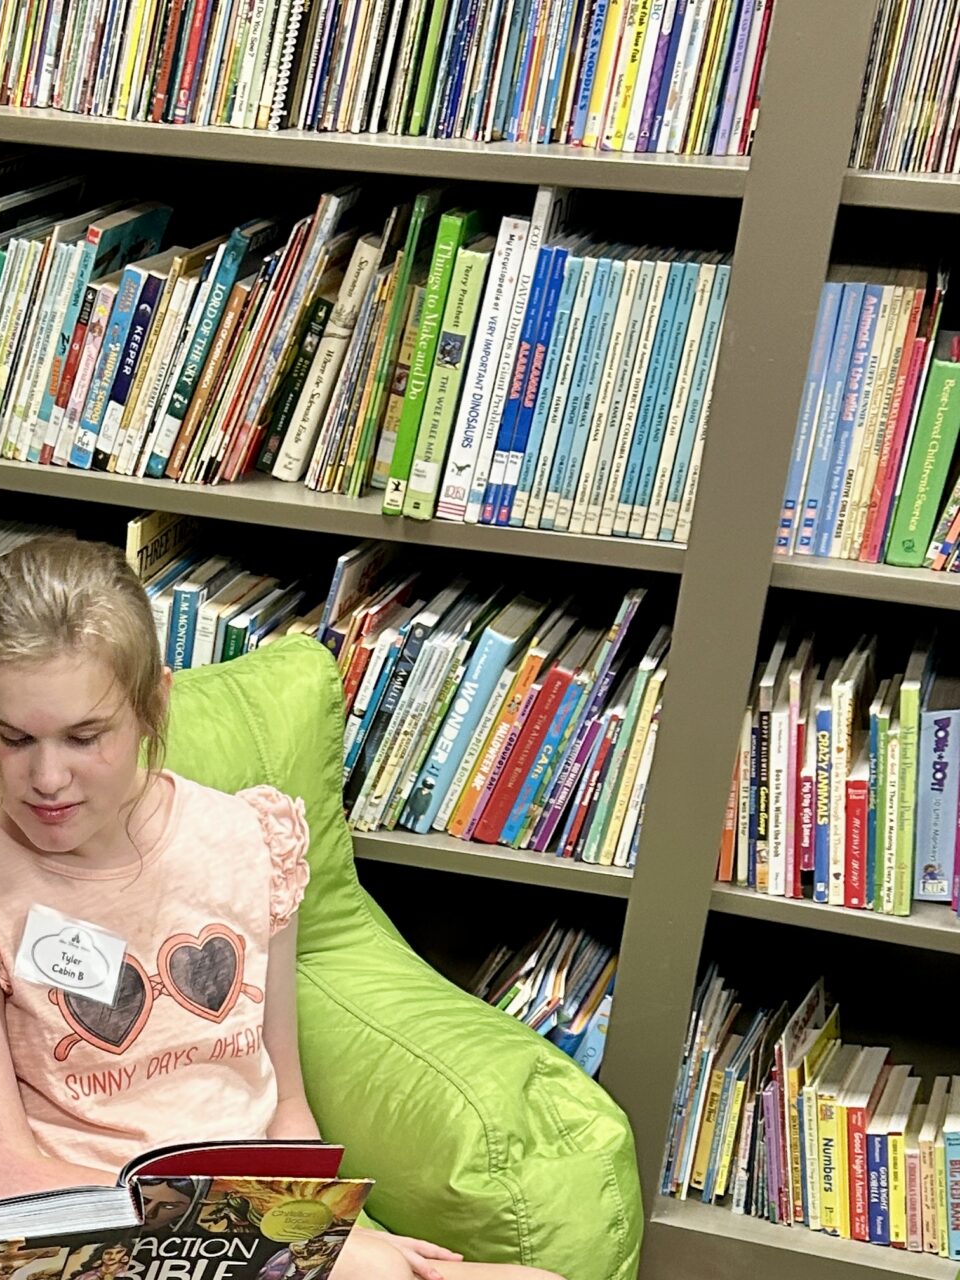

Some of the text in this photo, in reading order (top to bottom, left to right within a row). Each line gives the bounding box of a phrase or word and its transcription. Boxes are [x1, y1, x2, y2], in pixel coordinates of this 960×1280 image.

[245, 6, 264, 57] Do You See?
[451, 263, 472, 329] Terry Pratchett
[492, 246, 513, 300] Encyclopedia
[512, 273, 531, 315] DAVID
[180, 283, 227, 386] LORD OF THE SKY
[407, 238, 455, 401] Things to Make and Do
[485, 314, 499, 337] VERY
[503, 316, 522, 350] Drops
[856, 295, 877, 350] Animals
[123, 326, 144, 376] KEEPER
[321, 349, 335, 376] Where
[473, 338, 494, 390] IMPORTANT
[495, 360, 512, 391] Giant
[853, 351, 866, 364] in
[90, 351, 117, 425] MIDDLE SCHOOL
[847, 366, 862, 389] the
[298, 390, 316, 425] Sidewalk
[423, 374, 448, 463] THE WEE FREE MEN
[460, 392, 483, 449] DINOSAURS
[485, 393, 505, 440] Problem
[293, 425, 307, 445] Ends
[906, 378, 956, 531] Best-Loved Children's Stories
[837, 499, 848, 517] CHILD
[841, 468, 854, 498] CREATIVE
[430, 679, 479, 765] WONDER
[477, 720, 509, 774] HALLOWEEN
[815, 730, 831, 824] CRAZY ANIMALS
[52, 963, 85, 981] Cabin B
[61, 951, 82, 966] Tyler
[65, 1065, 137, 1101] SUNNY
[146, 1047, 198, 1080] DAYS
[820, 1137, 835, 1192] Numbers
[852, 1132, 865, 1213] Good Night America
[868, 1171, 878, 1202] GORILLA
[876, 1166, 888, 1187] GOOD
[132, 1236, 260, 1259] ACTION
